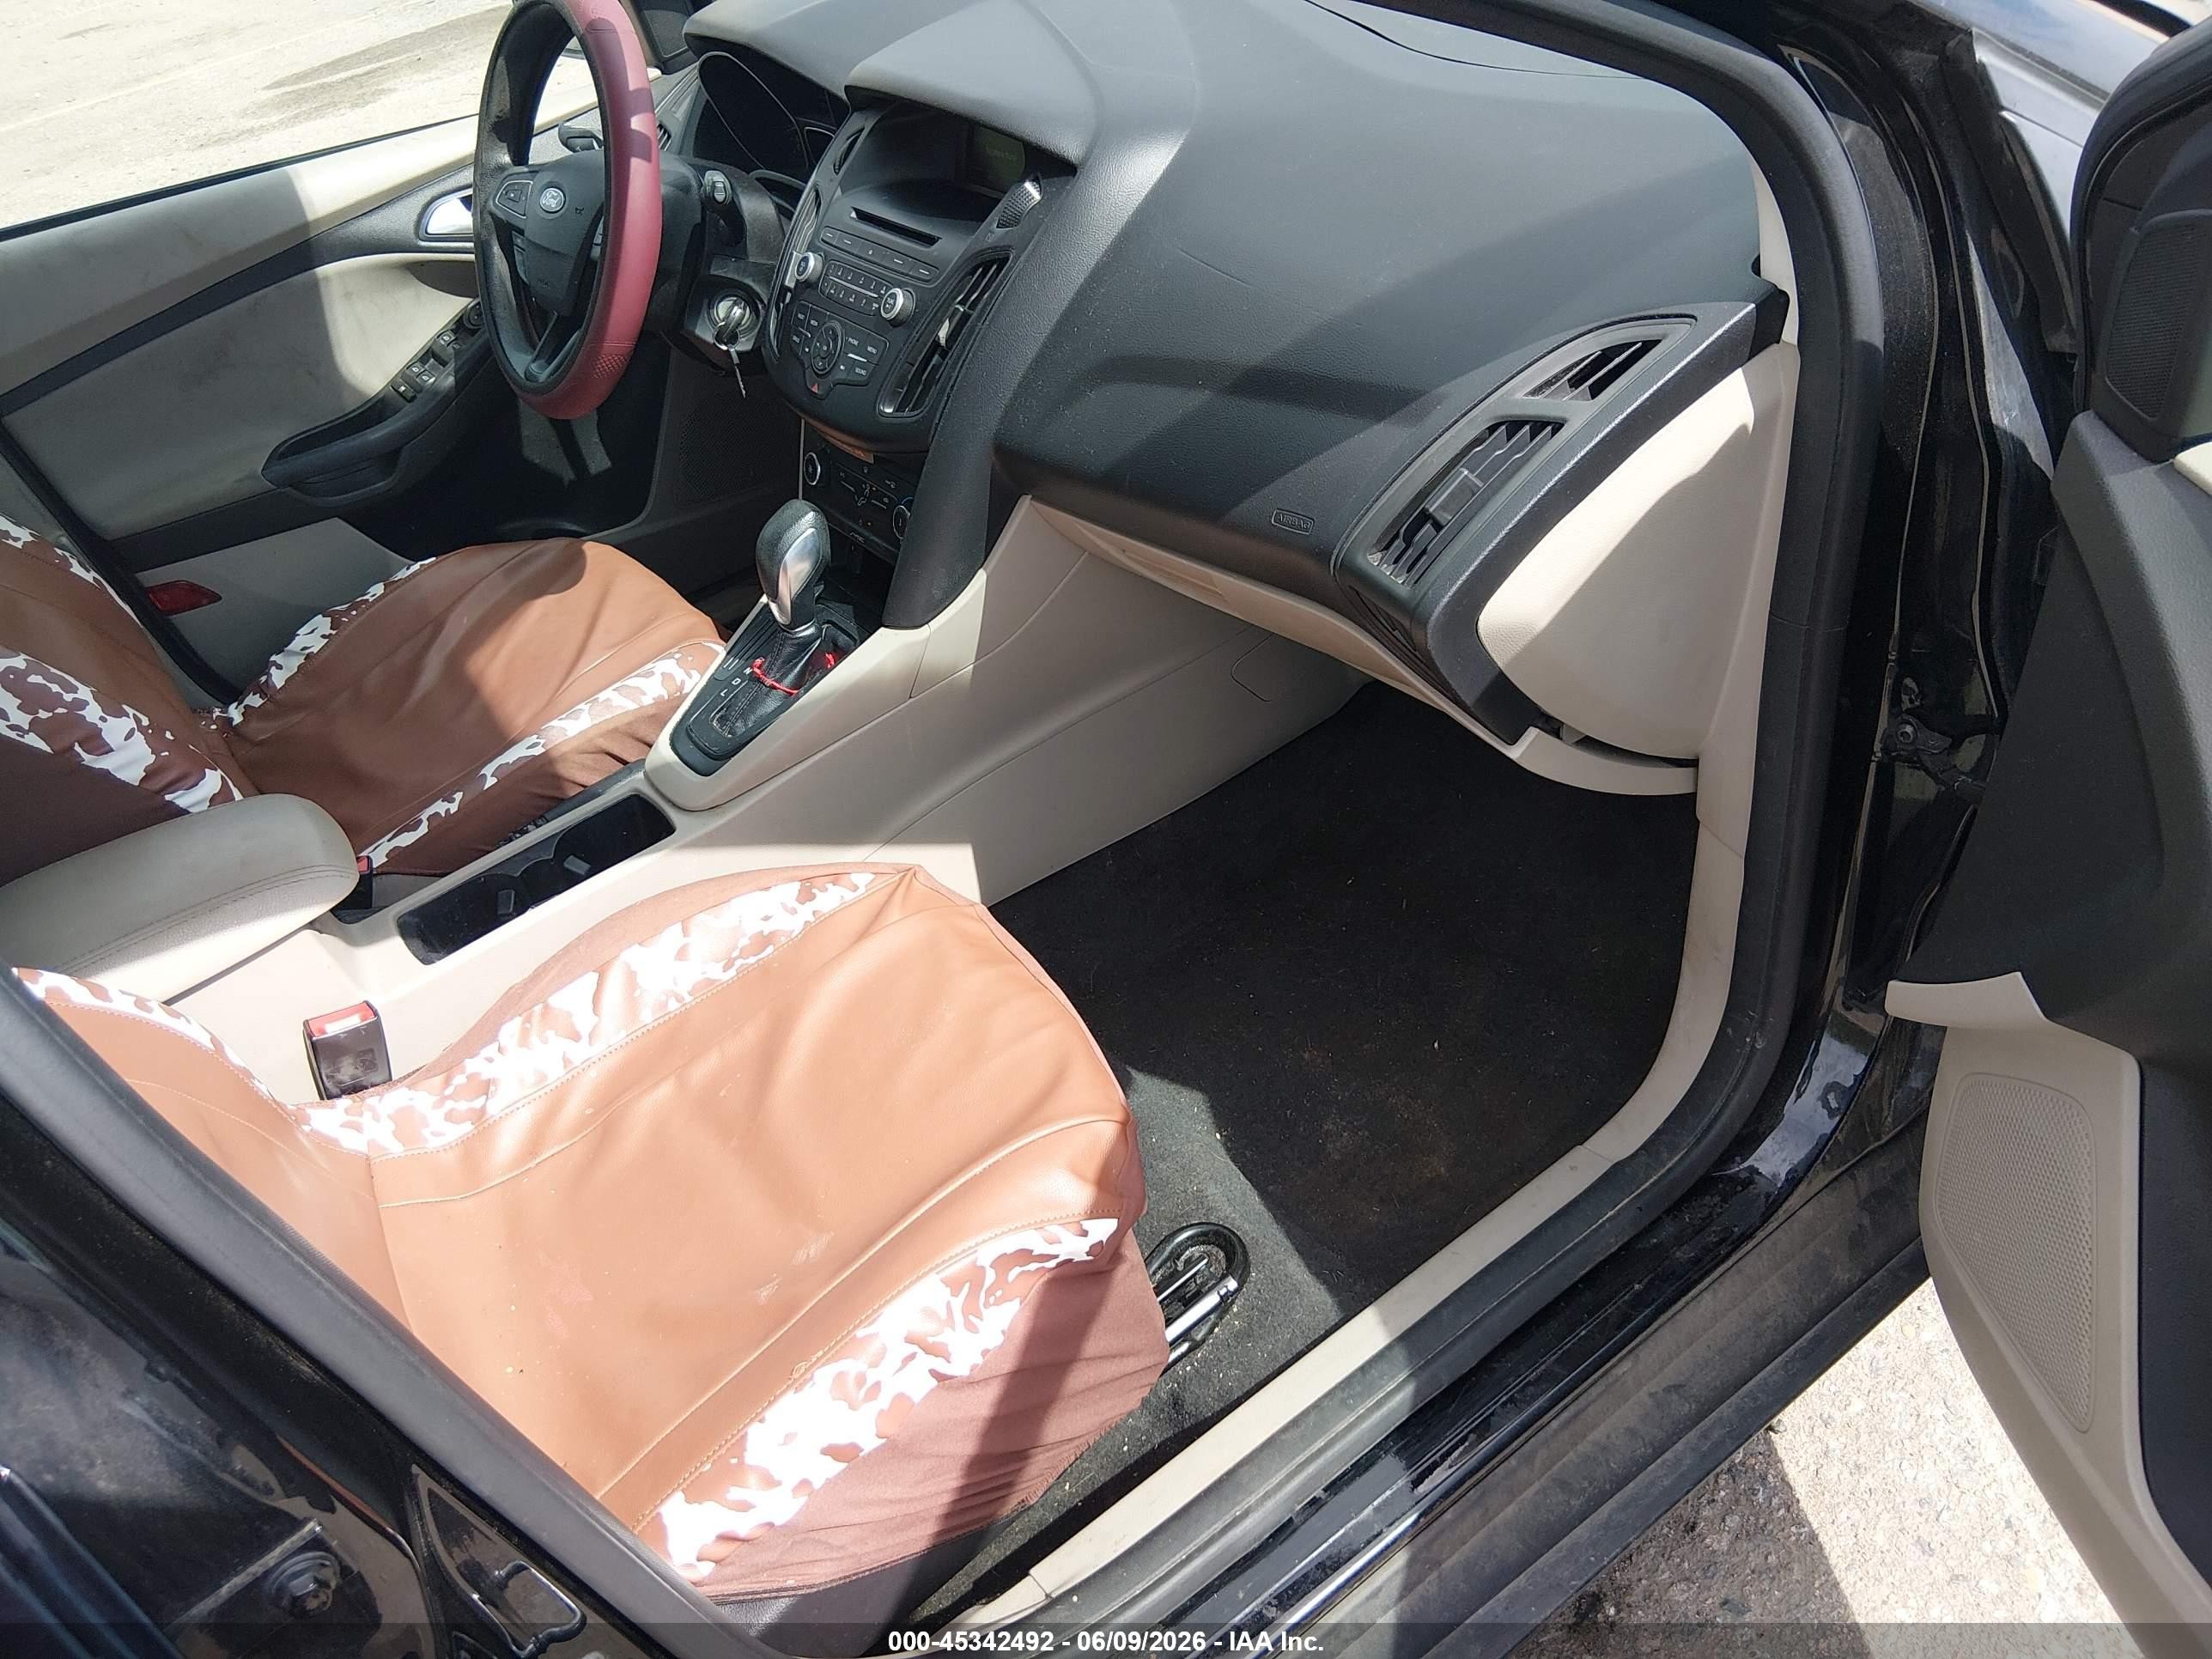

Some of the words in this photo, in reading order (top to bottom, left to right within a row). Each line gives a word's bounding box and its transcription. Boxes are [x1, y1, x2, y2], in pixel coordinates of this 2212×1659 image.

[542, 191, 561, 208] Ford
[1278, 513, 1311, 529] AIRBAG
[744, 666, 753, 675] N
